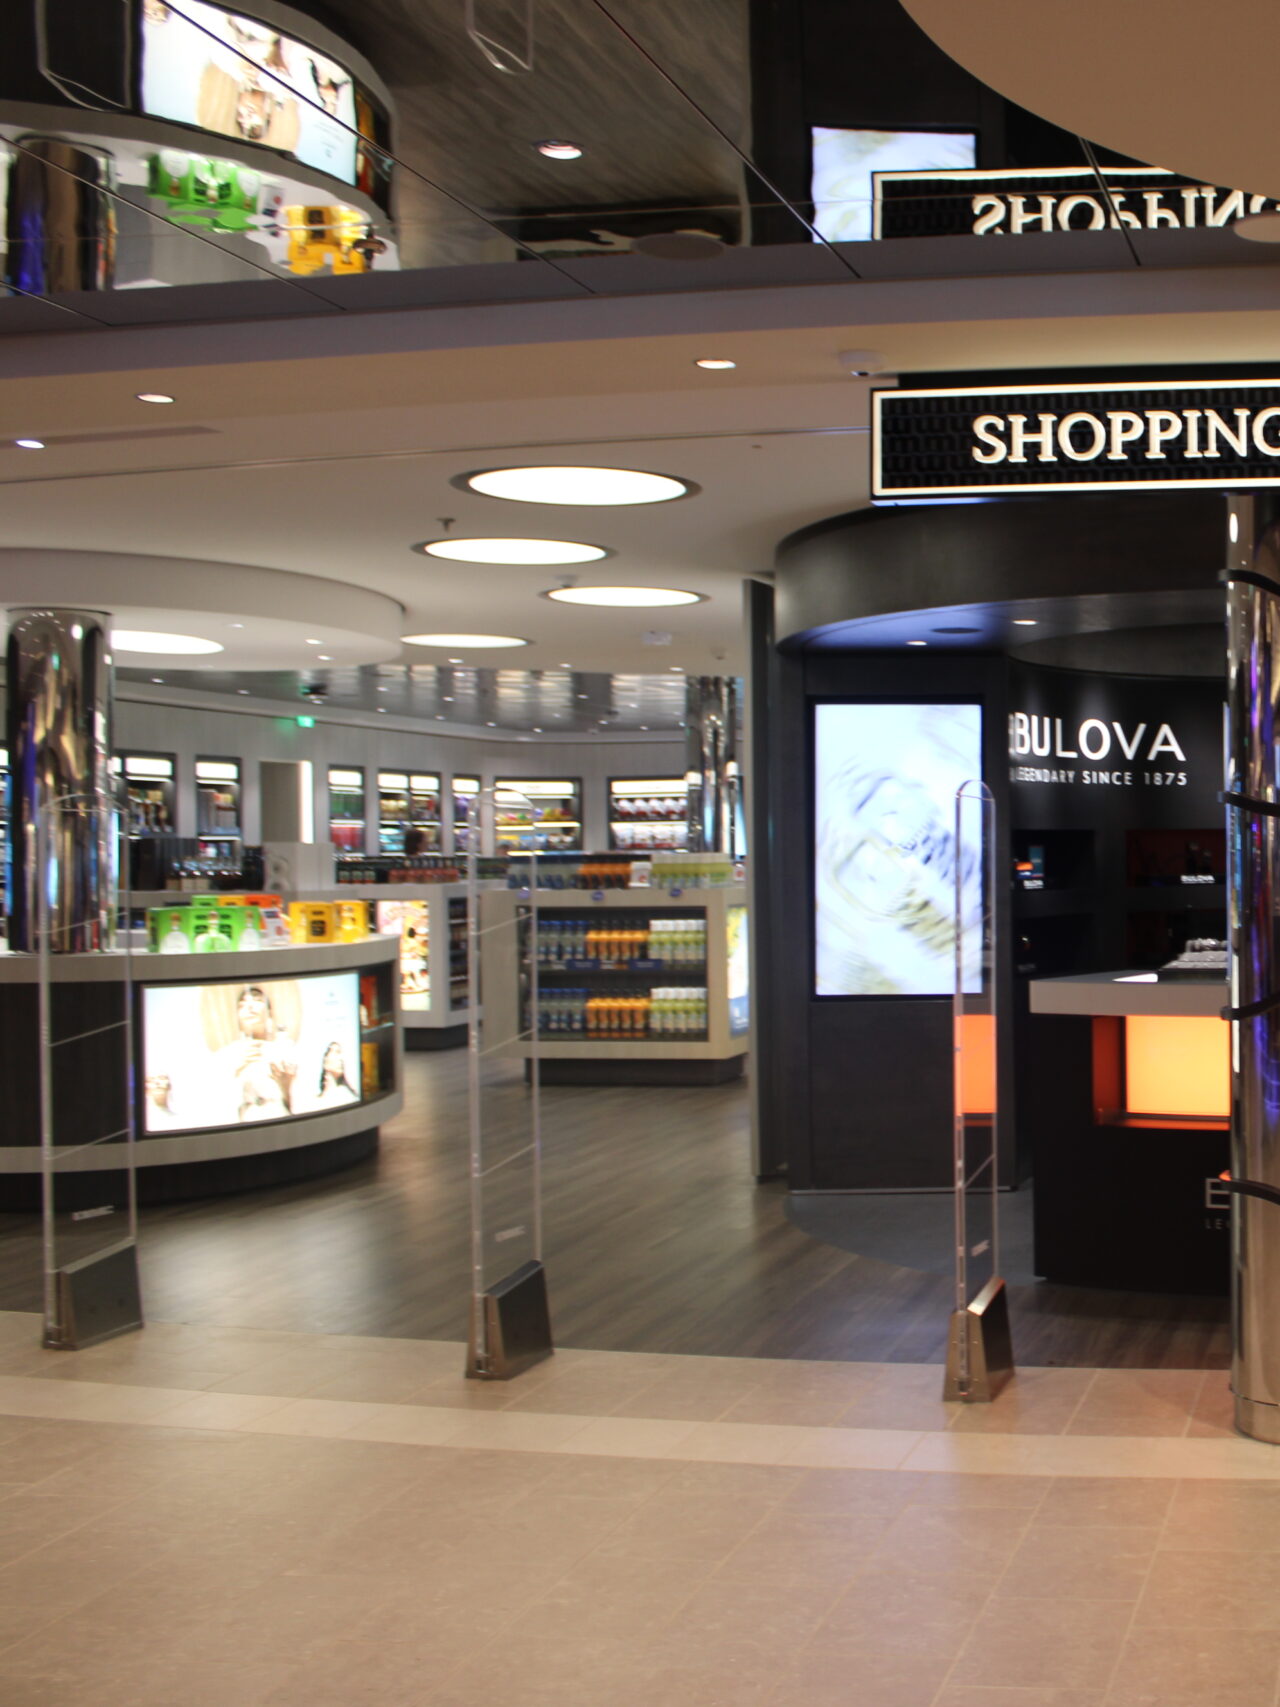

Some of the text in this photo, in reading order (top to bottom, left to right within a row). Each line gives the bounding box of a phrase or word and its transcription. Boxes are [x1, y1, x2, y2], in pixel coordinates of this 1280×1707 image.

[1009, 711, 1187, 762] BULOVA
[1011, 766, 1188, 786] LEGENDARY SINCE 1875
